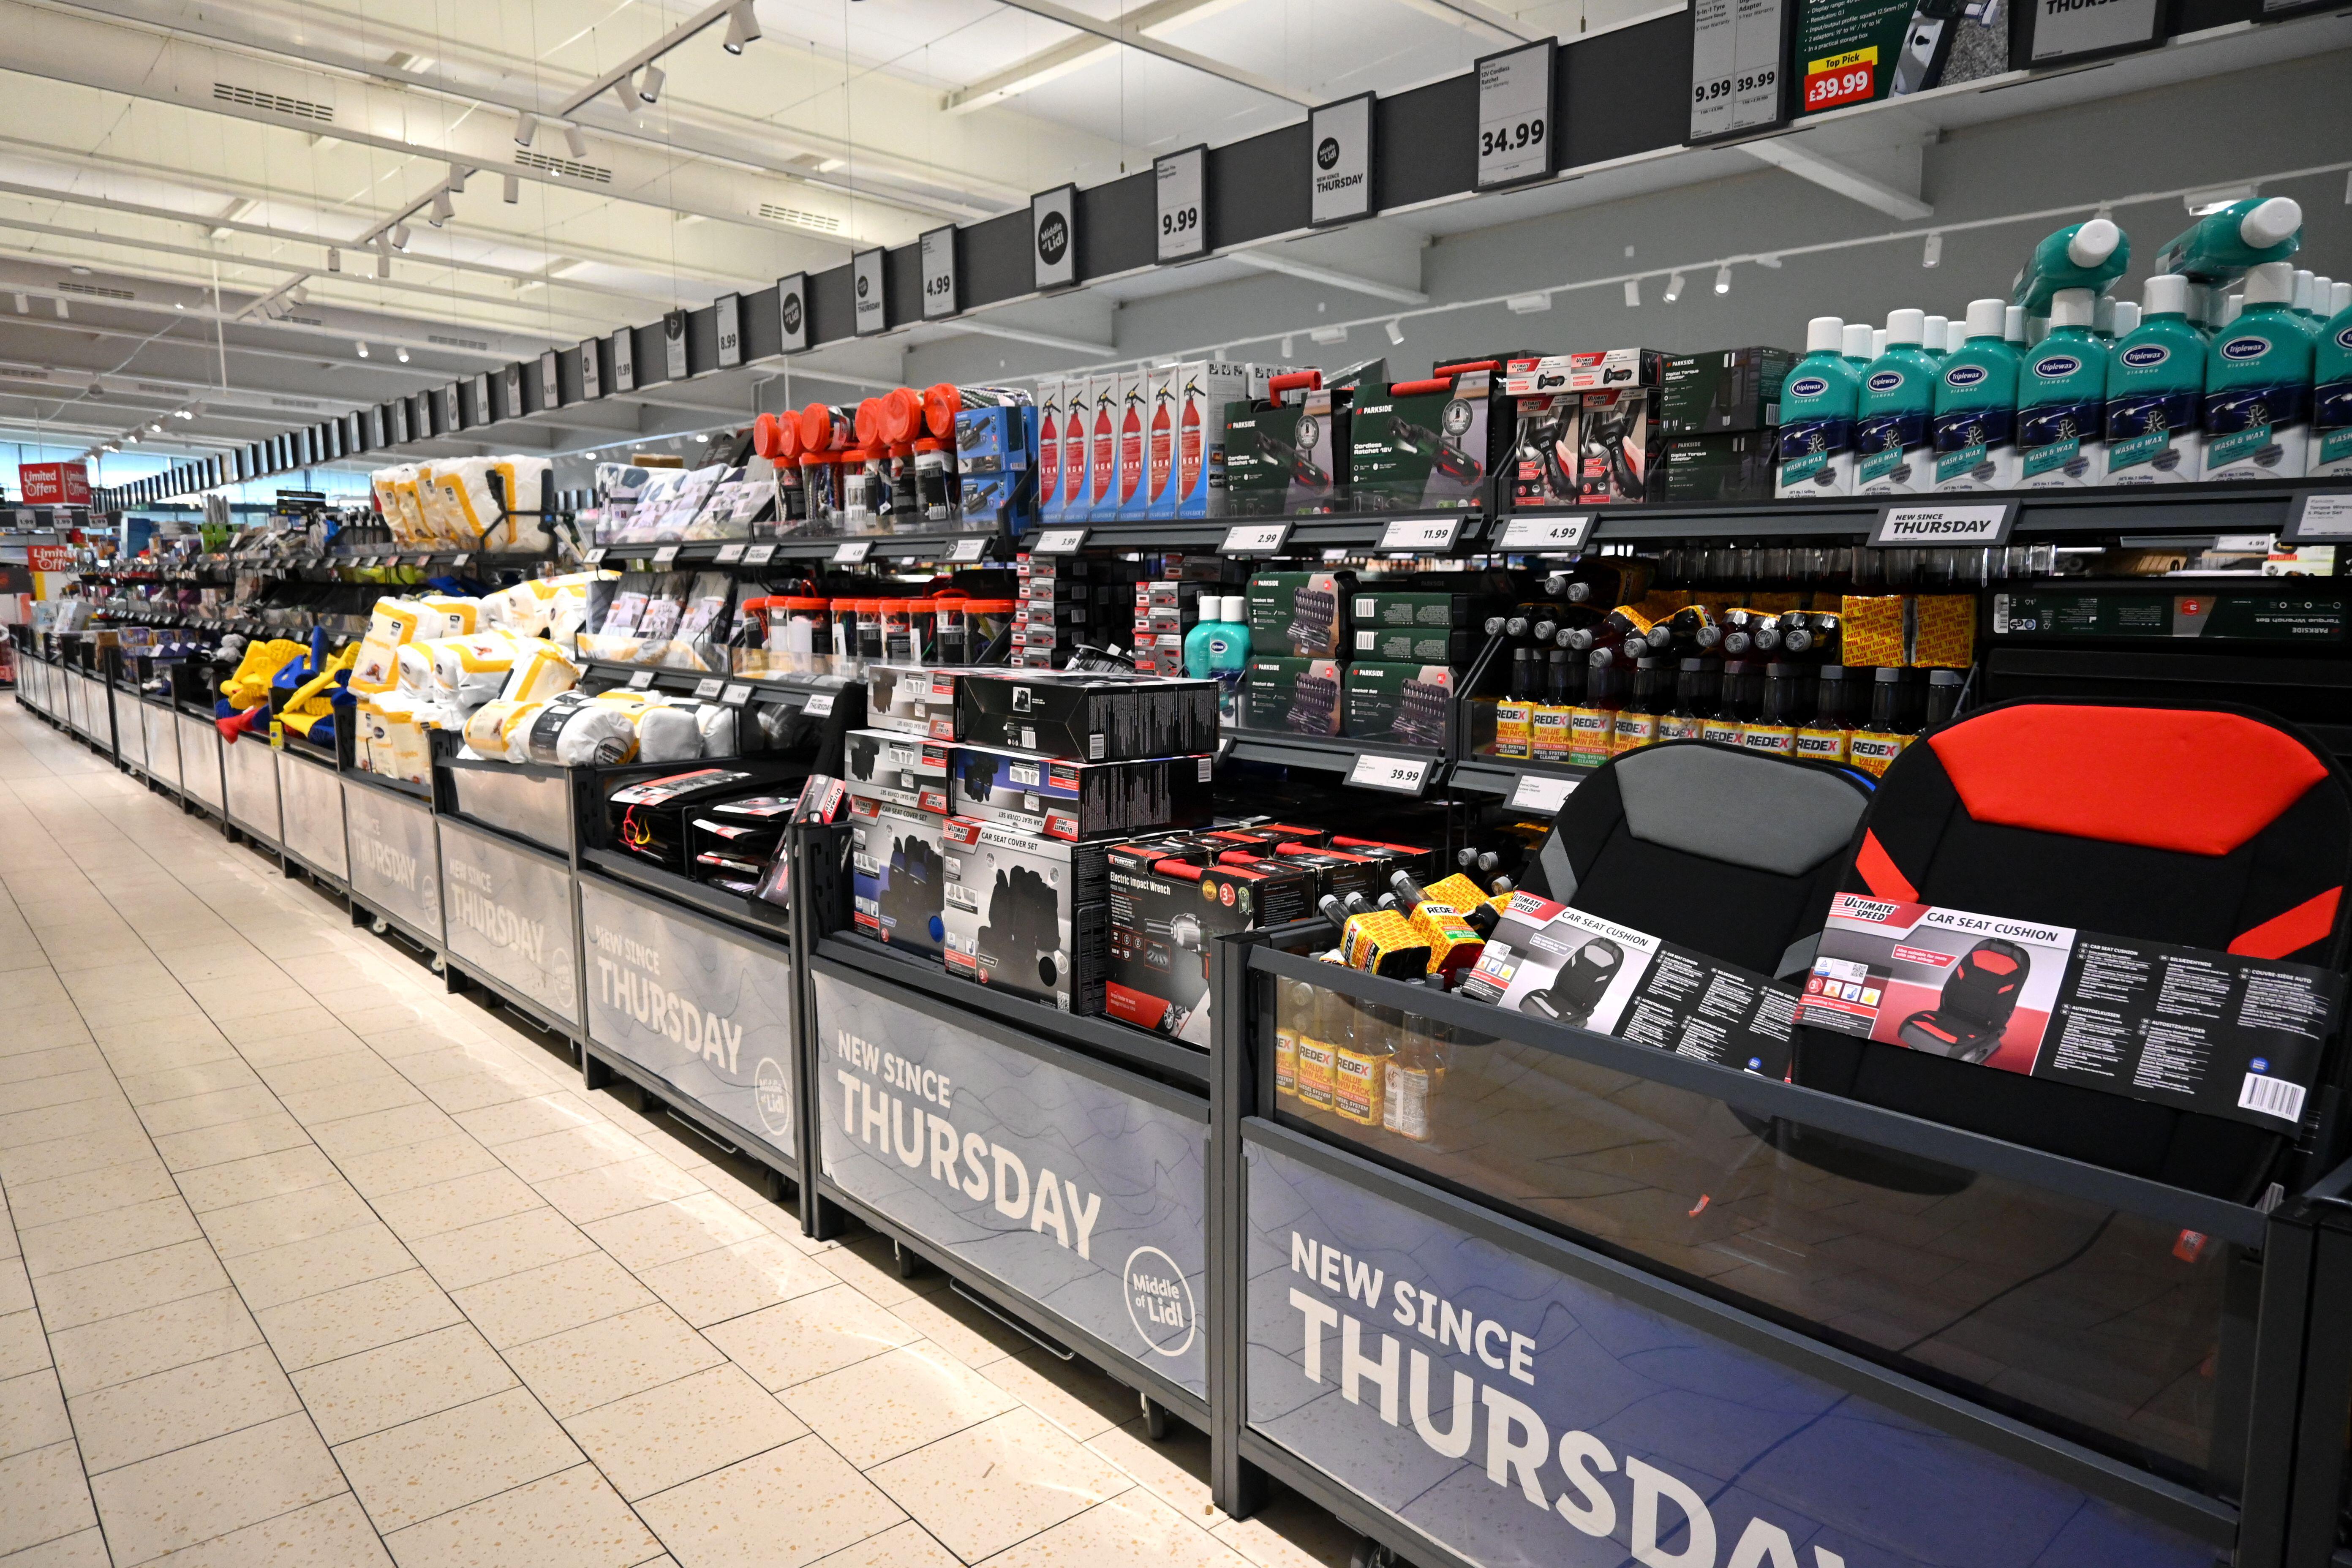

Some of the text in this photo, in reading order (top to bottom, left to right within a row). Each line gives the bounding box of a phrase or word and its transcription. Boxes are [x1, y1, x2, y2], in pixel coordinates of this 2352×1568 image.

[1739, 2, 1762, 13] Adaptor
[1810, 21, 1840, 33] Input/output
[1841, 16, 1858, 25] profile:
[1878, 6, 1896, 14] 12.5mm
[1811, 13, 1837, 23] Resolution:
[1813, 32, 1835, 41] adaptors:
[1818, 40, 1838, 50] practical
[1840, 36, 1858, 44] storage
[1826, 53, 1859, 68] Top Pick
[1490, 66, 1510, 76] Cordless
[1481, 76, 1499, 85] Ratchet
[1695, 71, 1775, 102] 9.99 39.99
[1809, 71, 1868, 102] £39.99
[1482, 119, 1544, 156] 34.99
[1317, 173, 1363, 193] THURSDAY
[1162, 208, 1197, 235] 9.99
[1041, 222, 1062, 242] Middle
[1048, 231, 1064, 252] Lidl
[926, 275, 950, 296] 4.99
[720, 333, 736, 350] 8.99
[2230, 344, 2262, 353] Triplewax
[2129, 352, 2161, 361] Triplewax
[2042, 362, 2072, 371] Triplewax
[1873, 378, 1897, 387] Triplewax
[1952, 372, 1979, 381] Triplewax
[1796, 384, 1821, 392] Triplewax
[1364, 405, 1392, 414] PARKSIDE
[1233, 421, 1255, 429] PARKSIDE
[2115, 436, 2162, 455] WASH WAX
[2215, 430, 2265, 451] WASH WAX
[1941, 449, 1980, 466] WASH WAX
[2029, 444, 2073, 461] WASH WAX
[1786, 455, 1823, 472] WASH WAX
[1863, 451, 1898, 469] WASH WAX
[24, 470, 56, 482] Limited
[67, 471, 87, 482] Limited
[25, 483, 57, 496] Offers
[69, 482, 87, 496] Offers
[1424, 529, 1448, 539] 11.99
[1550, 528, 1576, 538] 4.99
[1893, 520, 1991, 534] THURSDAY
[1258, 534, 1277, 542] 2.99
[1534, 715, 1566, 725] REDEX
[1573, 717, 1606, 729] REDEX
[1705, 731, 1744, 743] REDEX
[1746, 735, 1791, 748] REDEX
[1797, 738, 1839, 751] REDEX
[1852, 742, 1898, 756] REDEX
[1391, 769, 1419, 781] 39.99
[903, 811, 918, 819] COVER
[948, 823, 968, 835] ULTIMATE
[1054, 825, 1073, 834] ULTIMATE
[981, 832, 992, 841] CAR
[994, 835, 1007, 843] SEAT
[1008, 838, 1026, 847] COVER
[354, 833, 416, 892] THURSDAY
[1114, 857, 1135, 868] PARKSIDE
[449, 859, 492, 893] NEW SINCE
[1111, 871, 1129, 885] Electric
[1130, 877, 1149, 890] Impact
[1150, 881, 1171, 895] Wrench
[1512, 893, 1543, 908] ULTIMATE
[1514, 902, 1534, 913] SPEED
[1843, 896, 1895, 914] ULTIMATE
[1854, 908, 1886, 921] SPEED
[451, 883, 544, 965] THURSDAY
[1563, 911, 1649, 946] CAR SEAT CUSHION
[1927, 912, 2058, 942] CAR SEAT CUSHION
[595, 926, 660, 976] NEW SINCE
[597, 956, 742, 1075] THURSDAY
[2072, 1006, 2120, 1018] AUTOSTOELKUSSEN
[2152, 1020, 2205, 1034] AUTOSITZAUFLEGER
[1300, 1046, 1331, 1064] REDEX
[838, 1029, 950, 1108] NEW SINCE
[759, 1078, 783, 1094] Middle
[1342, 1073, 1362, 1085] VALUE
[1304, 1091, 1323, 1101] CLEANER
[1311, 1088, 1331, 1098] SYSTEM
[767, 1094, 784, 1114] Lidl
[1340, 1103, 1360, 1114] CLEANER
[1349, 1100, 1368, 1111] SYSTEM
[838, 1070, 1100, 1260] THURSDAY
[1133, 1273, 1179, 1300] Middle
[1135, 1296, 1183, 1327] of Lidl
[1292, 1231, 1535, 1386] NEW SINCE
